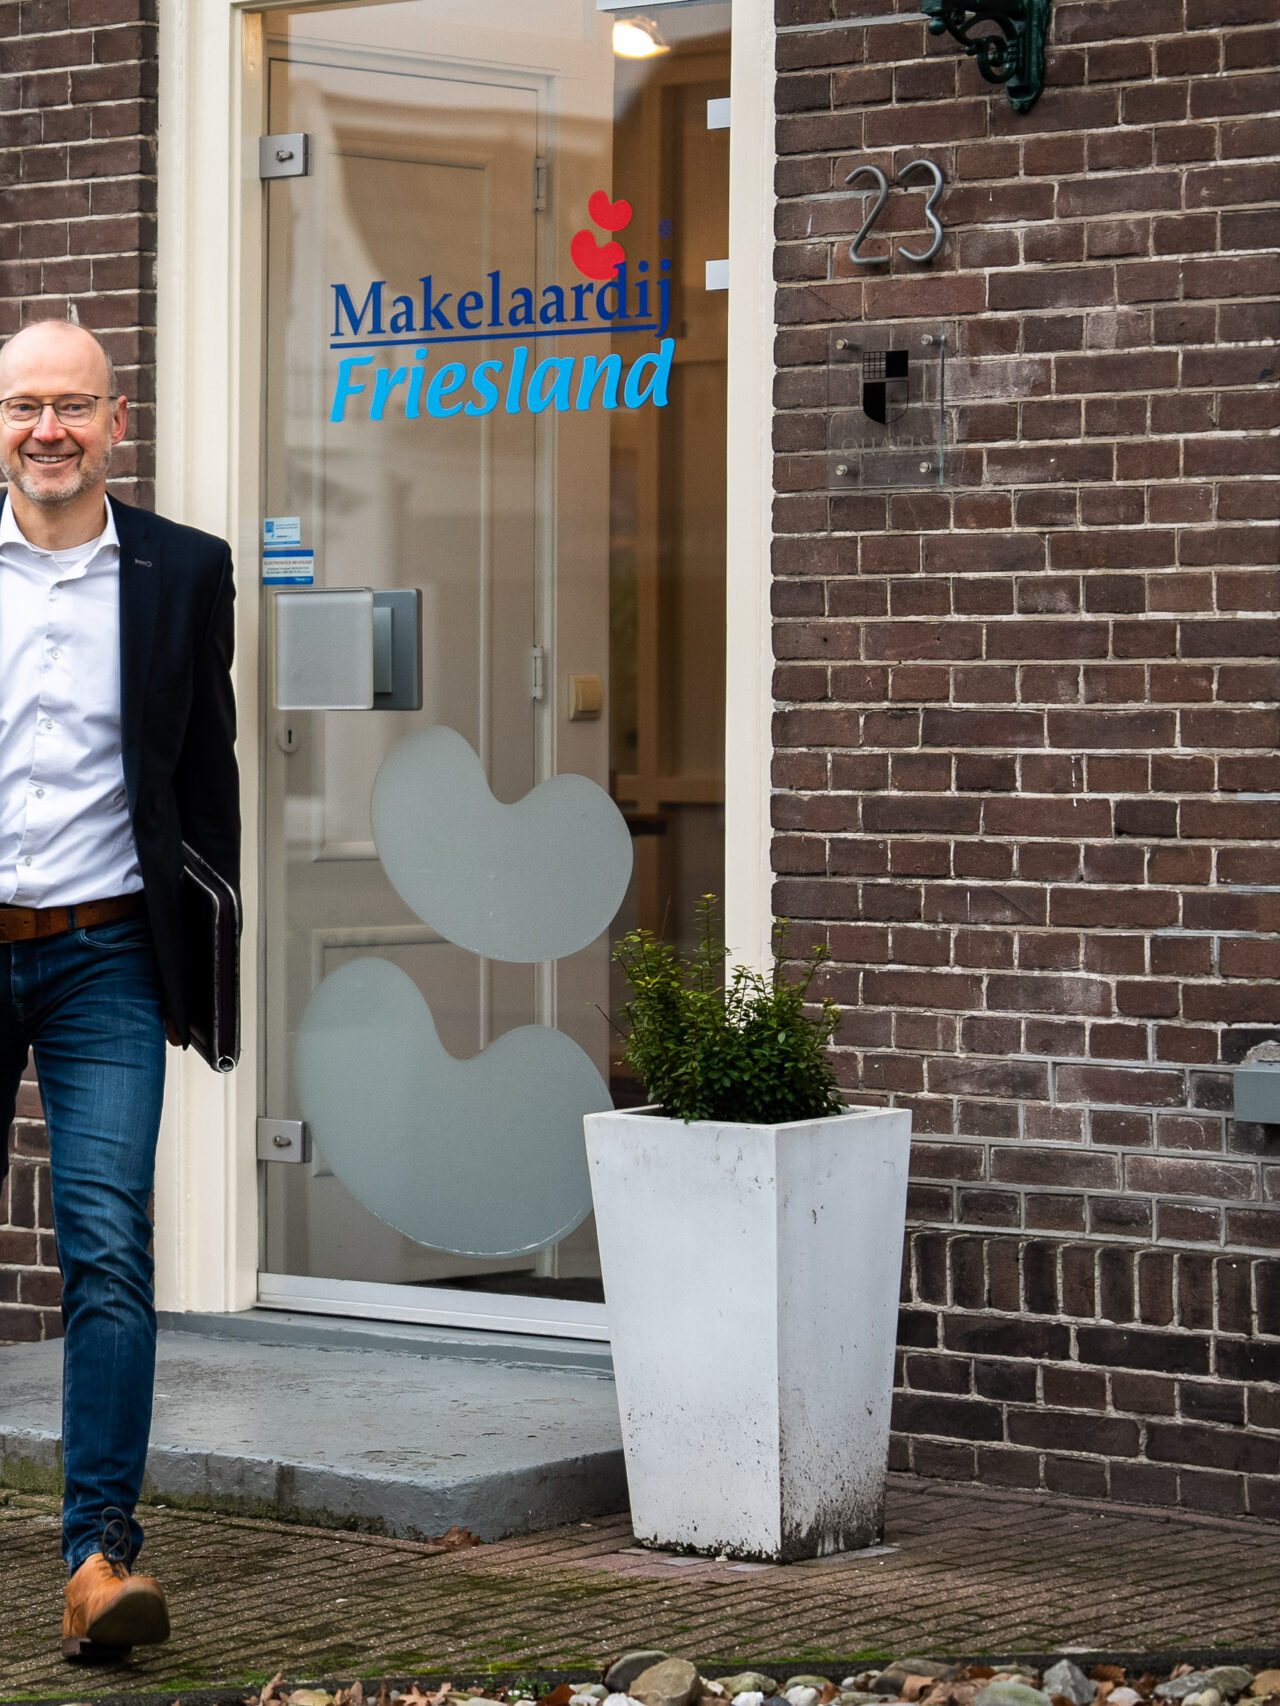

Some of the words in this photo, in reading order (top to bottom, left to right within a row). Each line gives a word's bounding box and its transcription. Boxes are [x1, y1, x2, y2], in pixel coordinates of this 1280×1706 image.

[845, 159, 944, 265] 23
[330, 258, 671, 338] Makelaardij
[330, 337, 676, 422] Friesland
